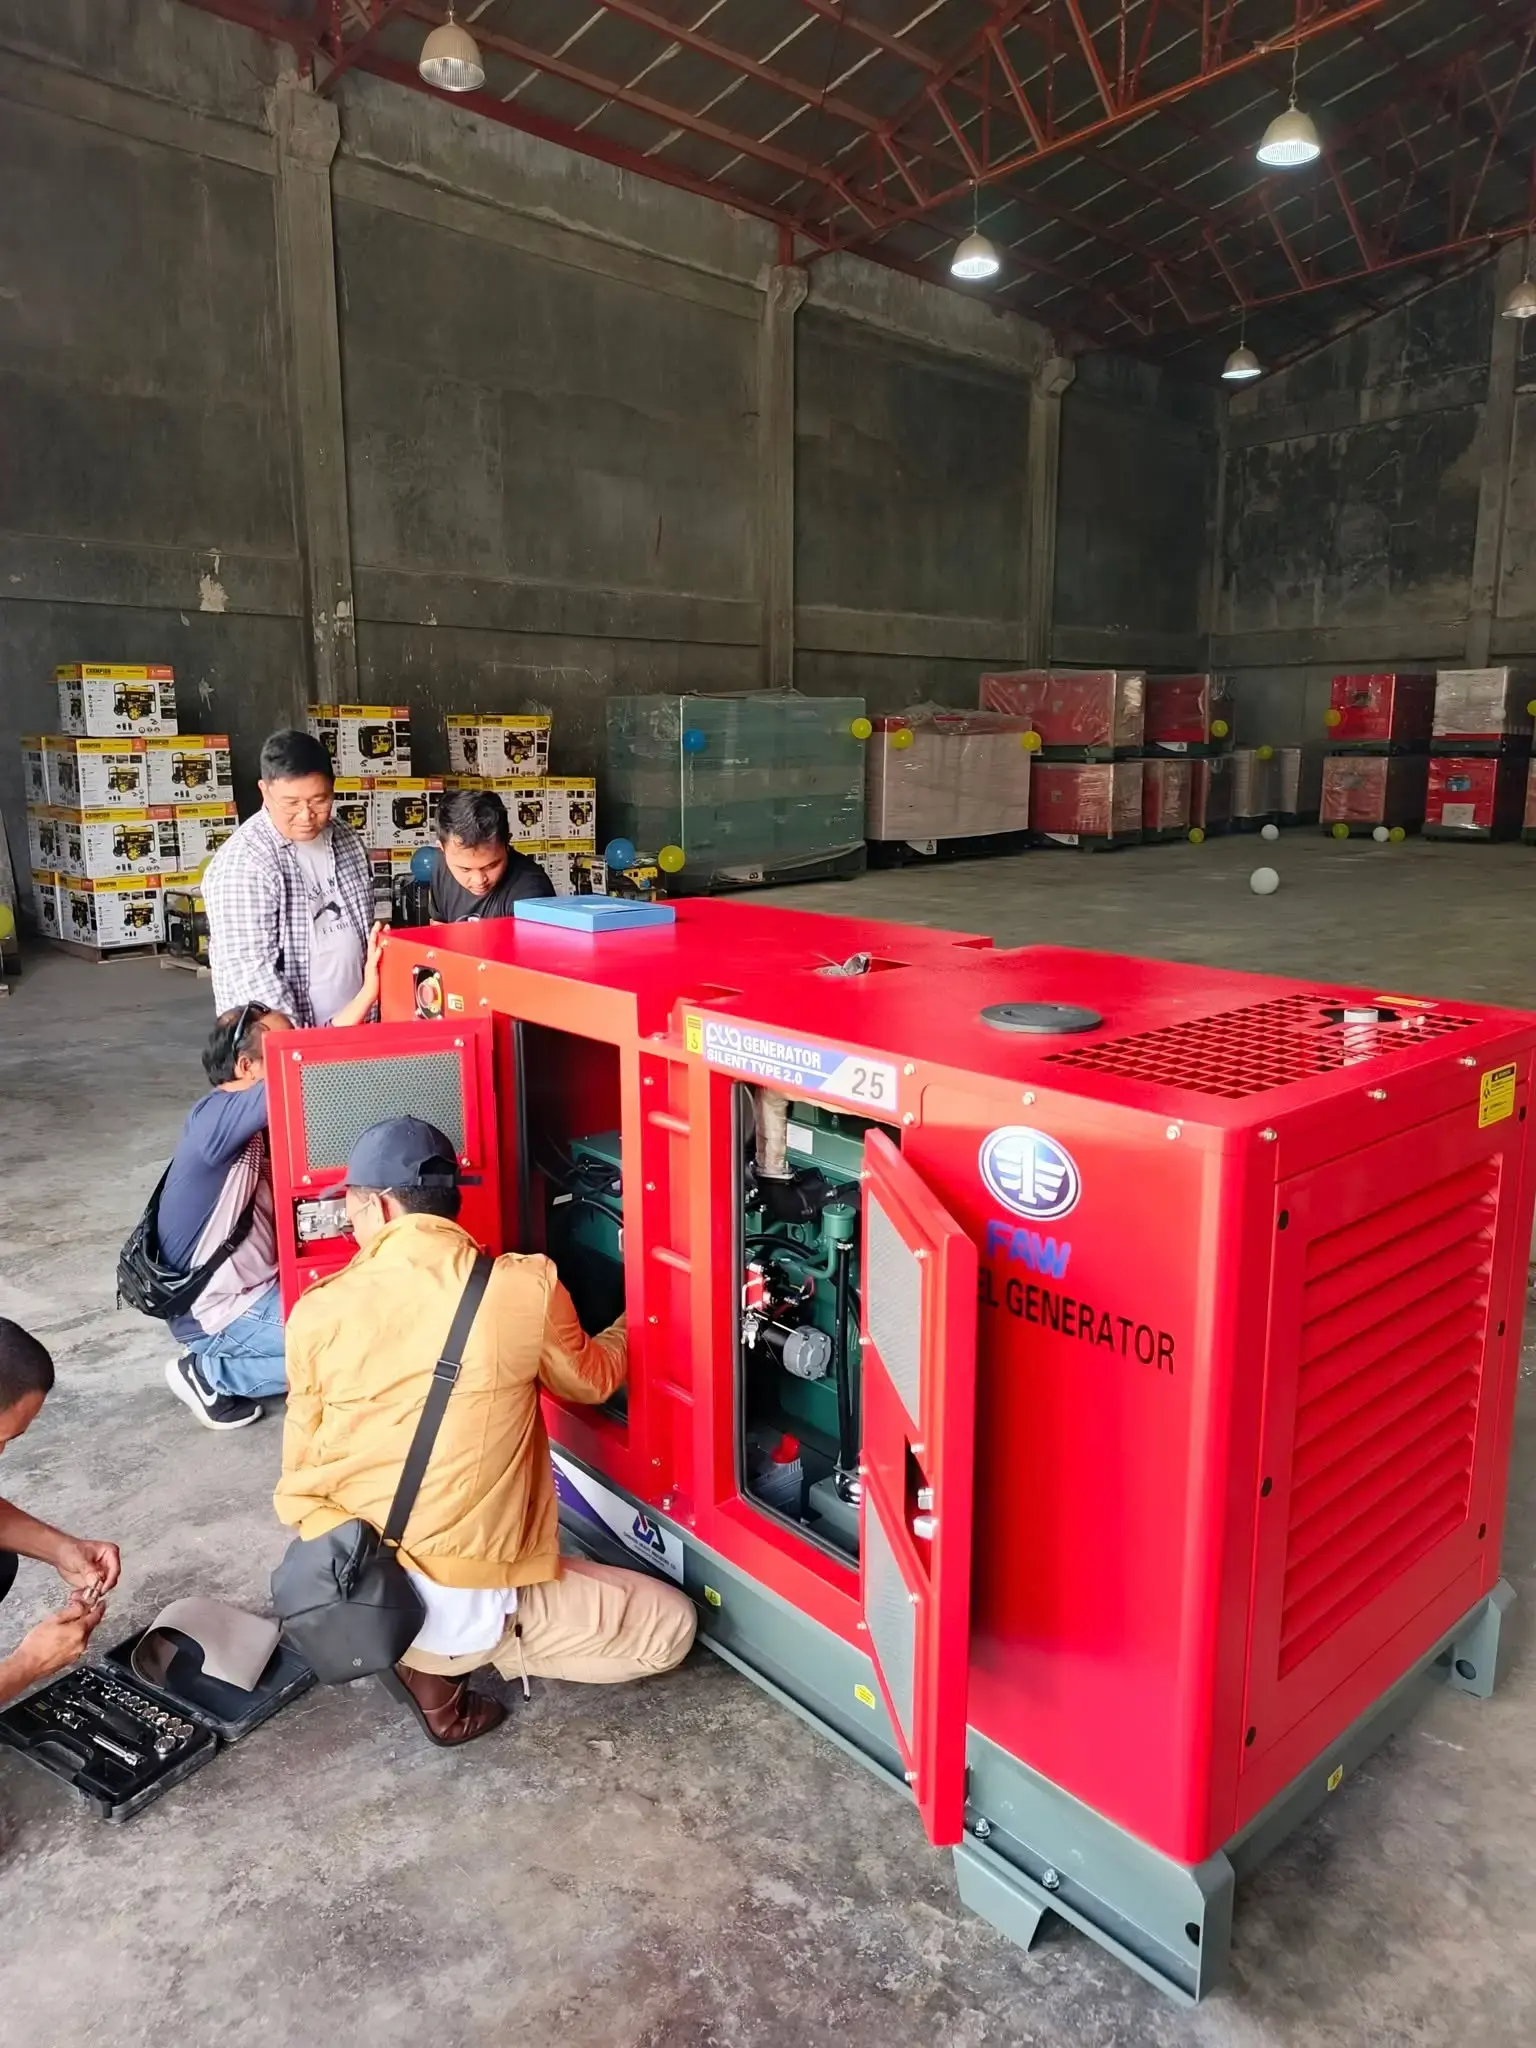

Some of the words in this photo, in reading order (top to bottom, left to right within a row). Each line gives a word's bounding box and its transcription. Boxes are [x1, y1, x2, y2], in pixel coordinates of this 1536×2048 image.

[706, 1048, 748, 1072] SILENT
[750, 1057, 782, 1080] TYPE
[783, 1069, 803, 1086] 2.0
[743, 1035, 822, 1070] GENERATOR
[851, 1067, 885, 1100] 25
[986, 1219, 1072, 1279] FAW
[1006, 1278, 1176, 1374] GENERATOR
